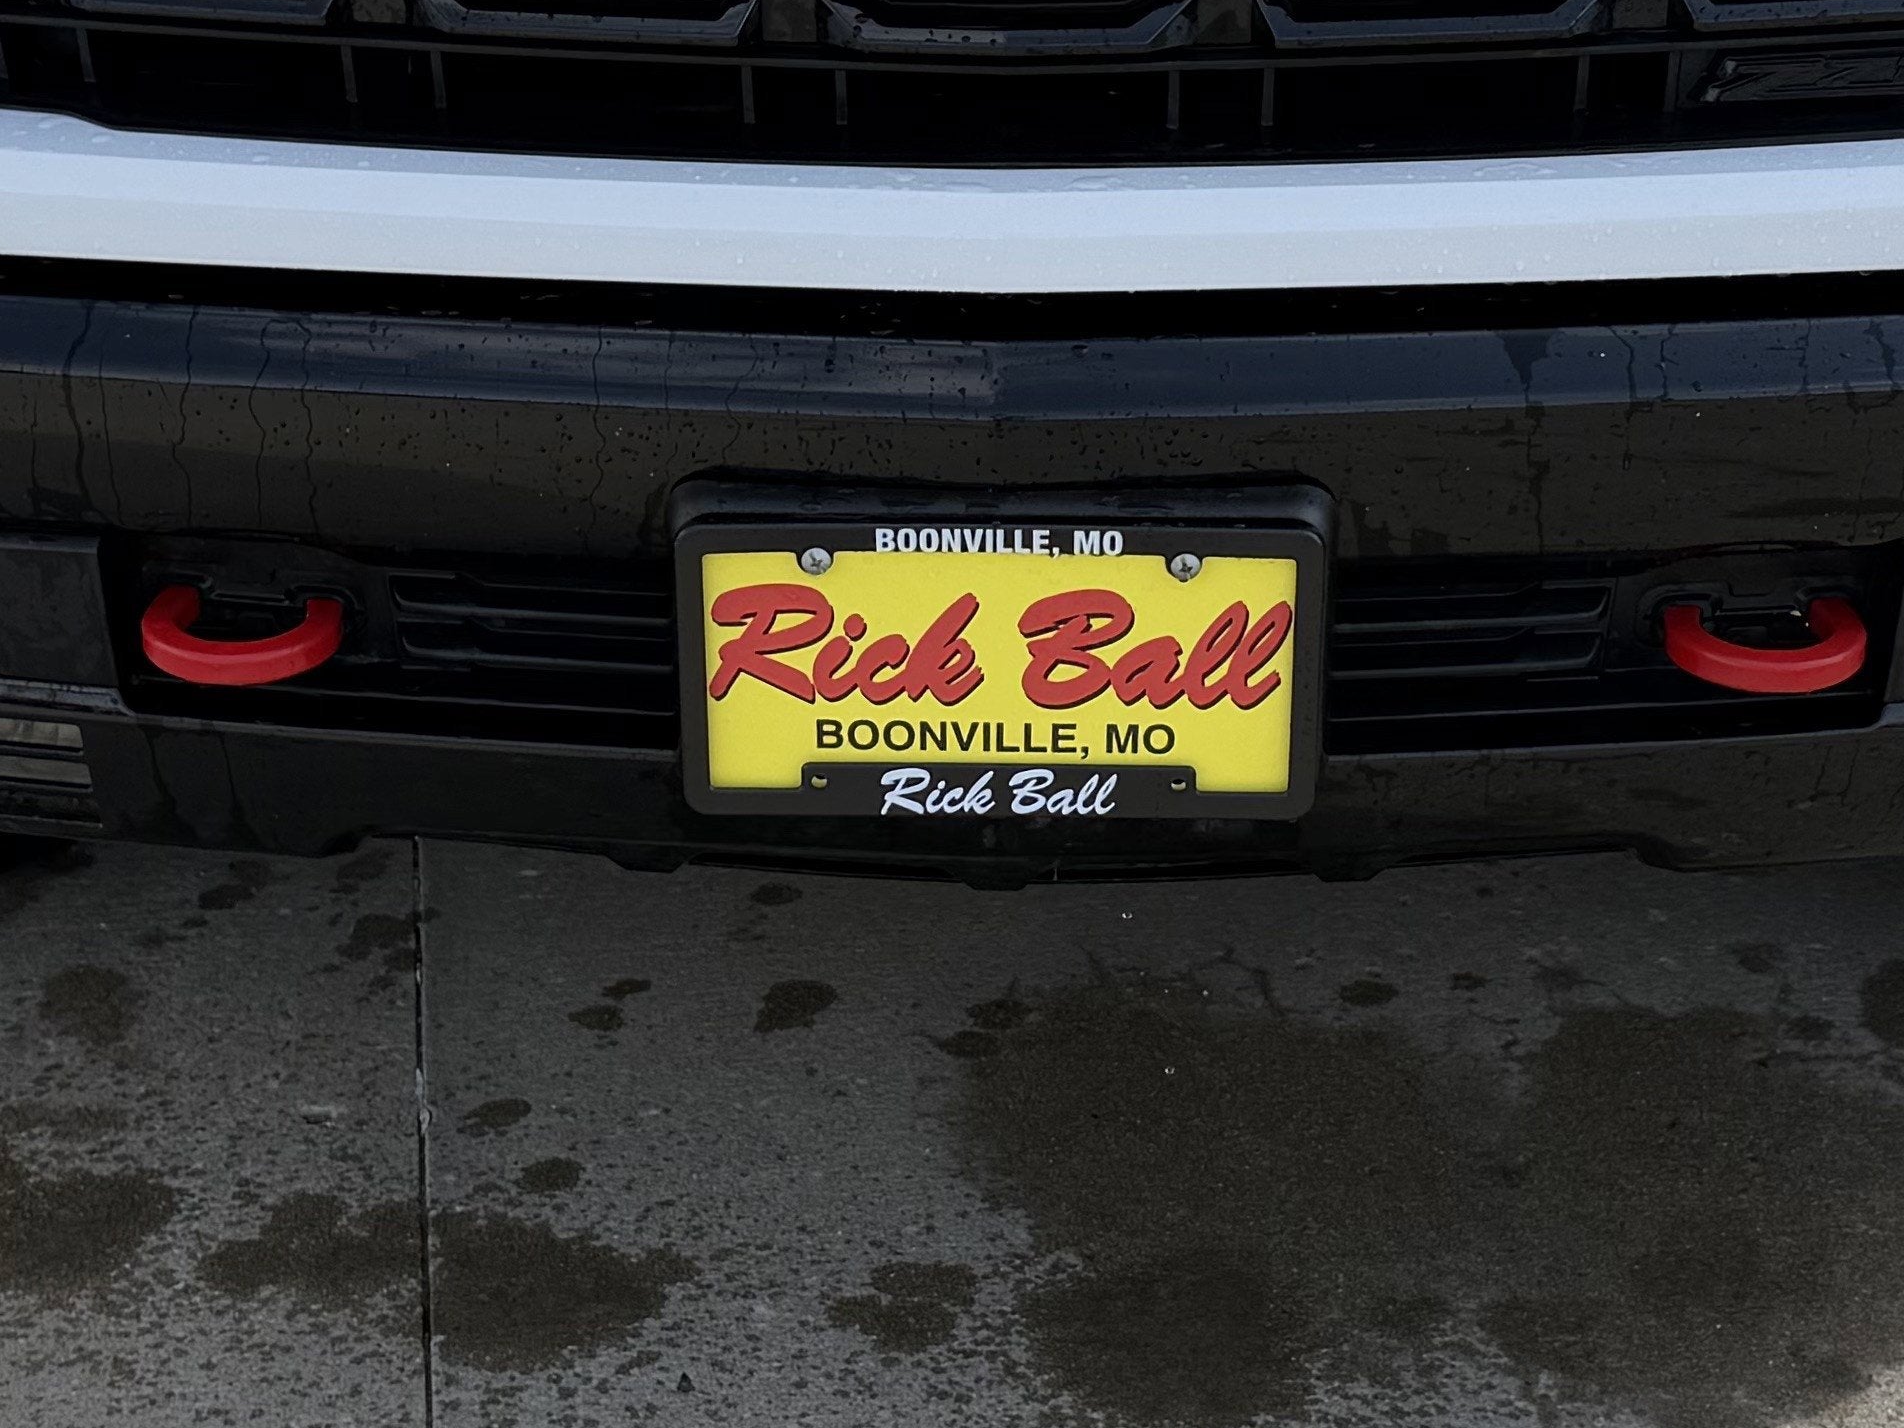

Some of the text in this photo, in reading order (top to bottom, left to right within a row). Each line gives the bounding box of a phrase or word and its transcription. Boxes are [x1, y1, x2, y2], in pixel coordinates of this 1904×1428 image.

[874, 528, 1125, 558] BOONVILLE, MO
[709, 582, 1293, 710] Rick Ball
[815, 718, 1176, 759] BOONVILLE, MO
[879, 767, 1118, 816] Rick Ball
